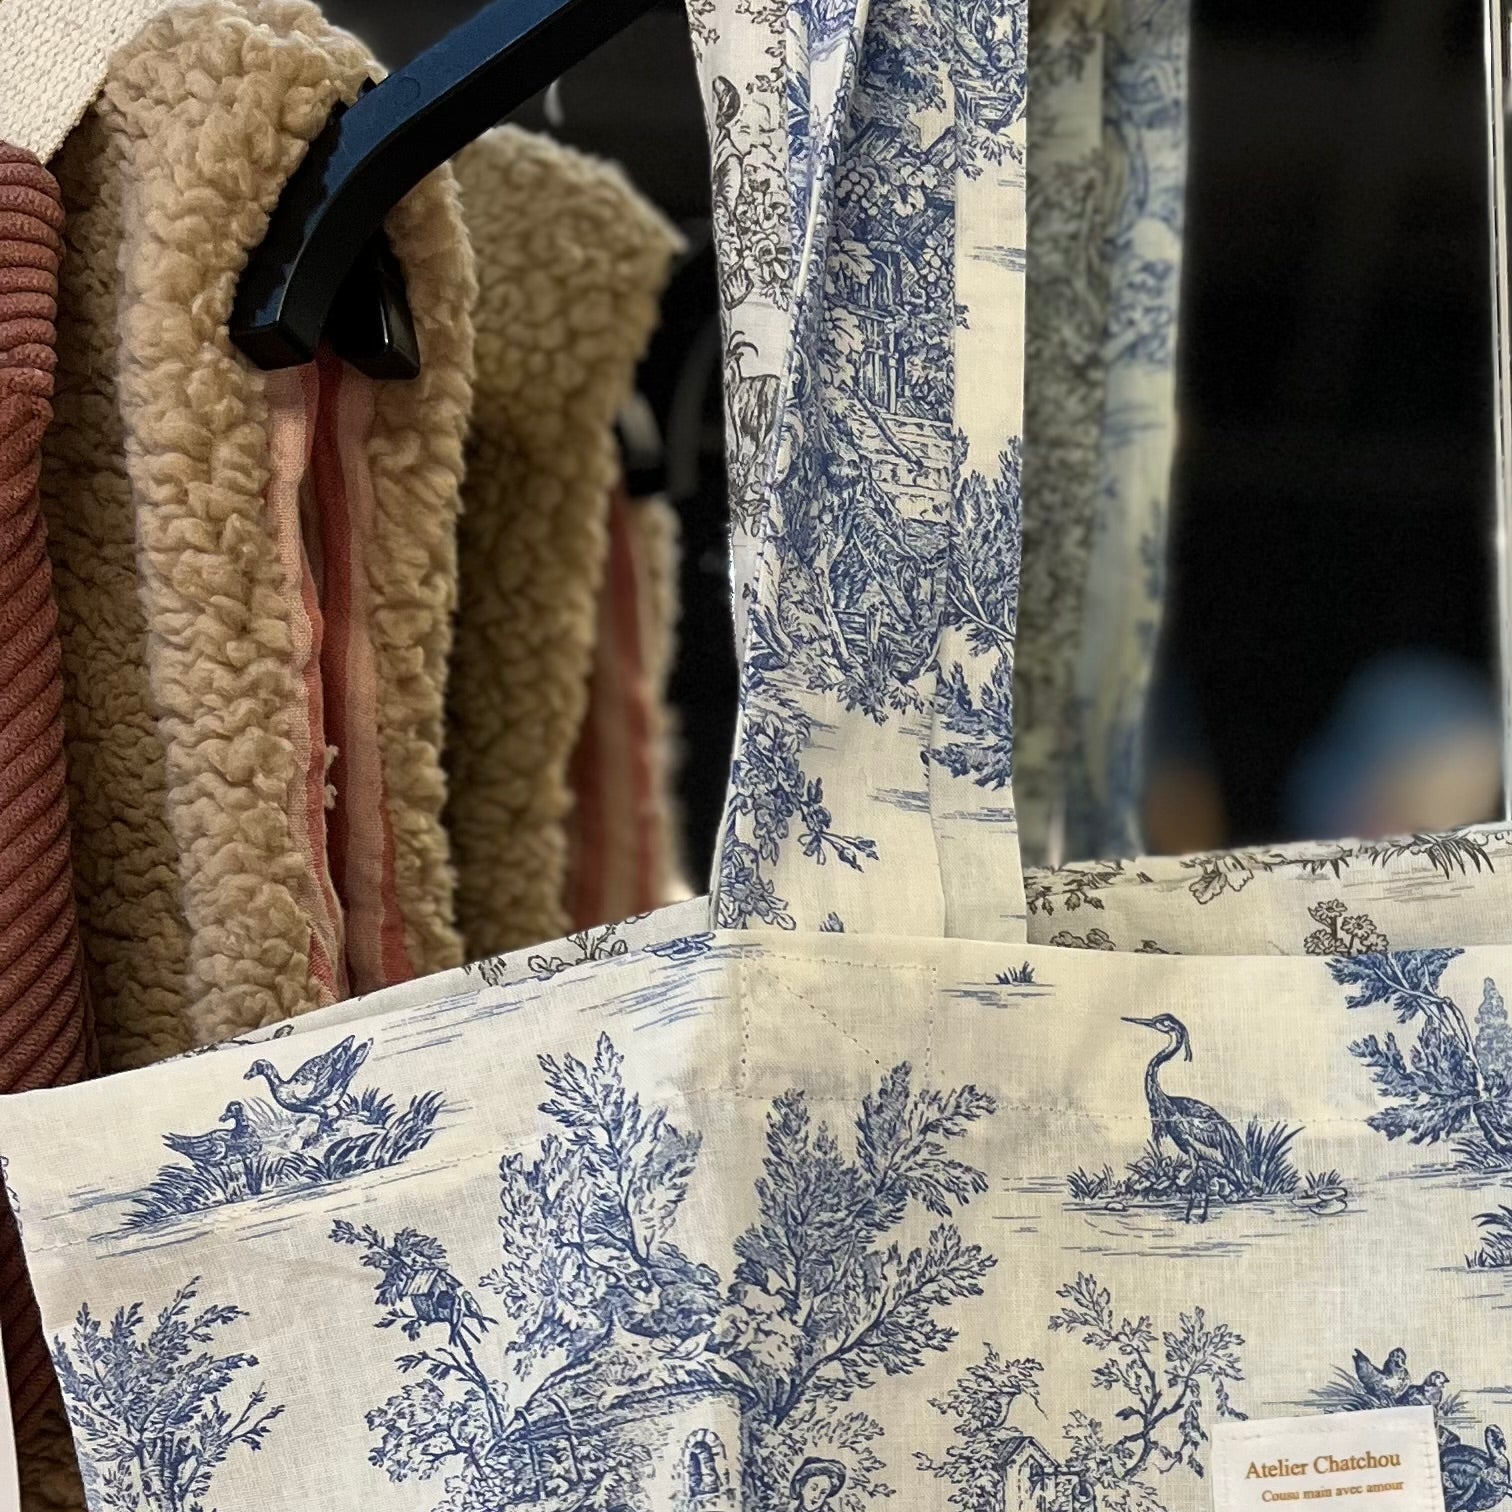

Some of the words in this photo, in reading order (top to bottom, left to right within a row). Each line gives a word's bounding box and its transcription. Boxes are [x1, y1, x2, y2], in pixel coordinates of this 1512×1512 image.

[1245, 1459, 1308, 1479] Atelier
[1313, 1451, 1401, 1474] Chatchou
[1261, 1490, 1300, 1502] Cousu
[1303, 1488, 1332, 1499] main
[1336, 1485, 1363, 1496] avec
[1366, 1481, 1404, 1493] amour
